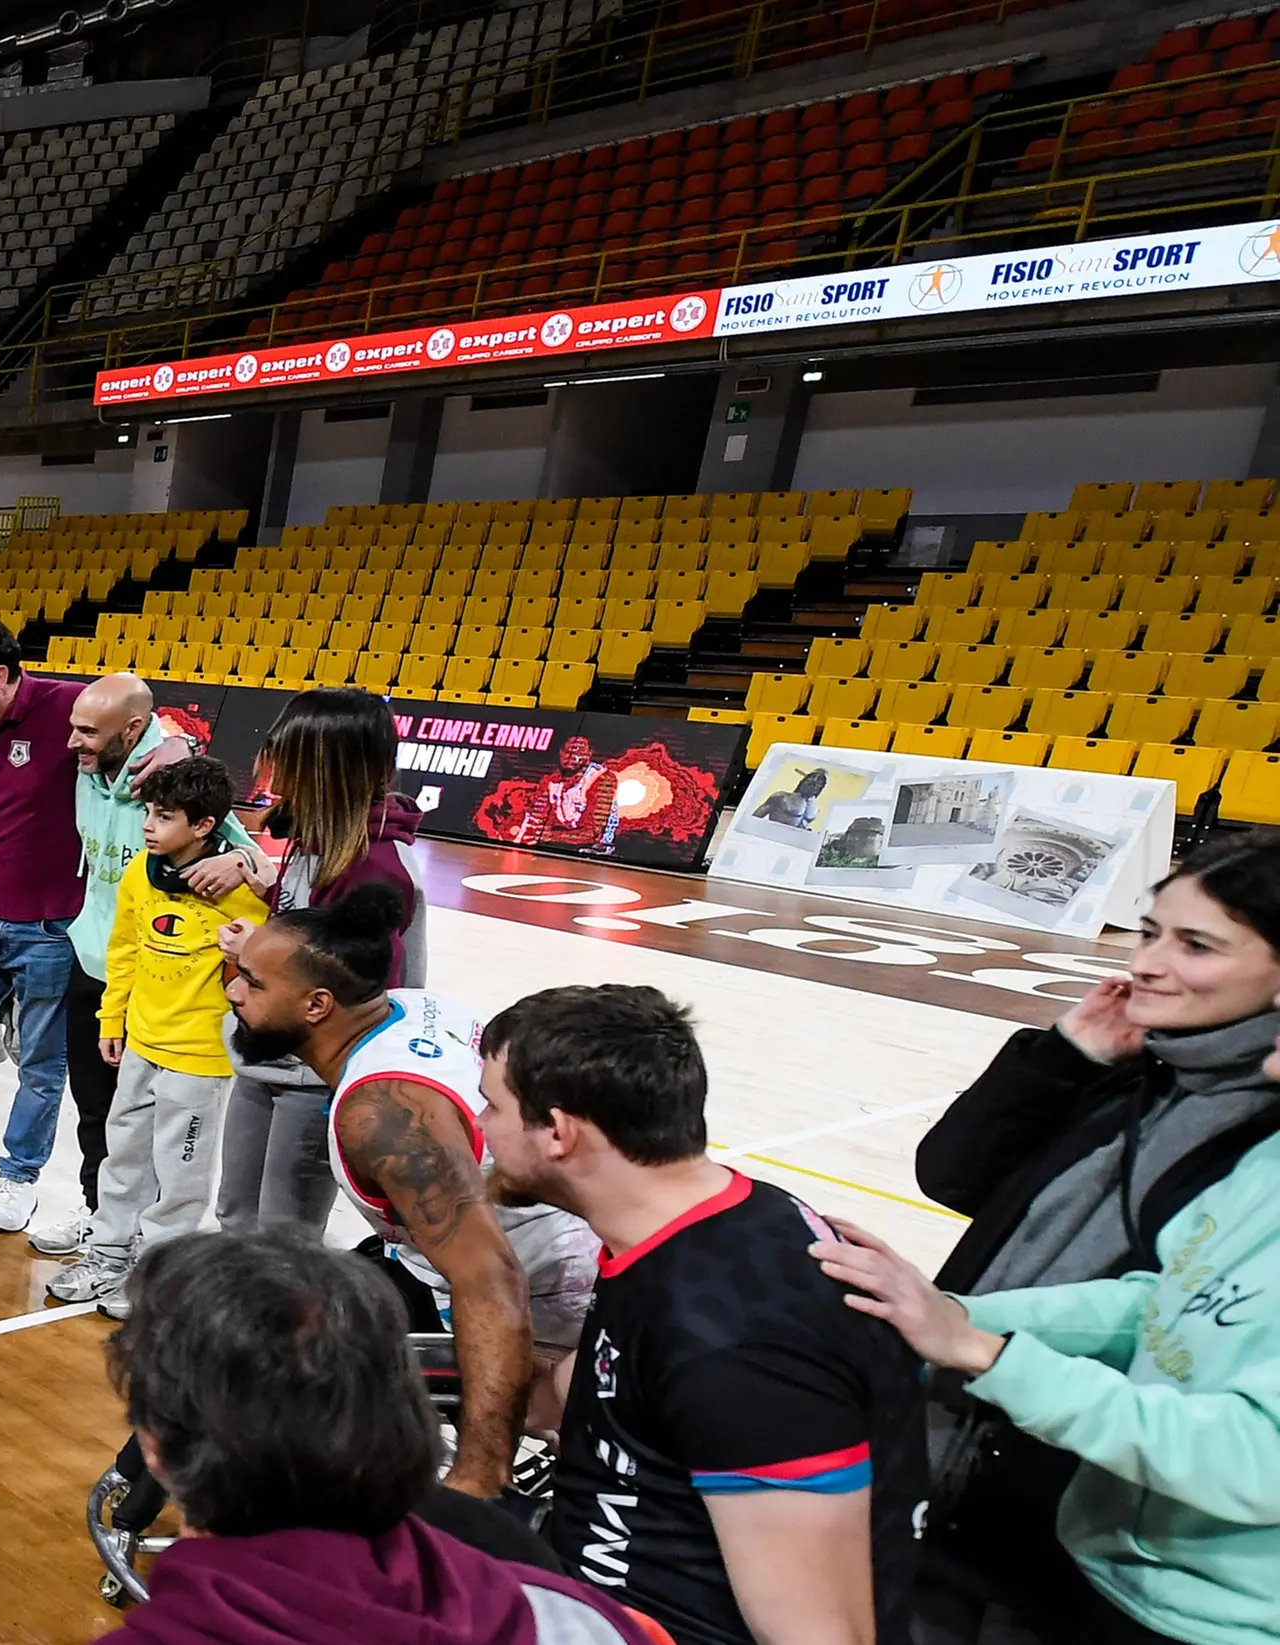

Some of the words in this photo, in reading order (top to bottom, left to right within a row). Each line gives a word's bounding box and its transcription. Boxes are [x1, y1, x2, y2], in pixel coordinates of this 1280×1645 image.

[986, 283, 1075, 301] MOVEMENT
[1081, 271, 1190, 292] REVOLUTION
[577, 309, 666, 334] expert
[720, 315, 790, 331] MOVEMENT
[795, 305, 882, 322] REVOLUTION
[459, 326, 537, 349] expert
[354, 340, 423, 362] expert
[176, 365, 232, 383] expert
[260, 355, 323, 373] expert
[101, 375, 152, 392] expert
[416, 716, 555, 752] COMPLEANNO
[183, 1114, 200, 1153] ALWAYS
